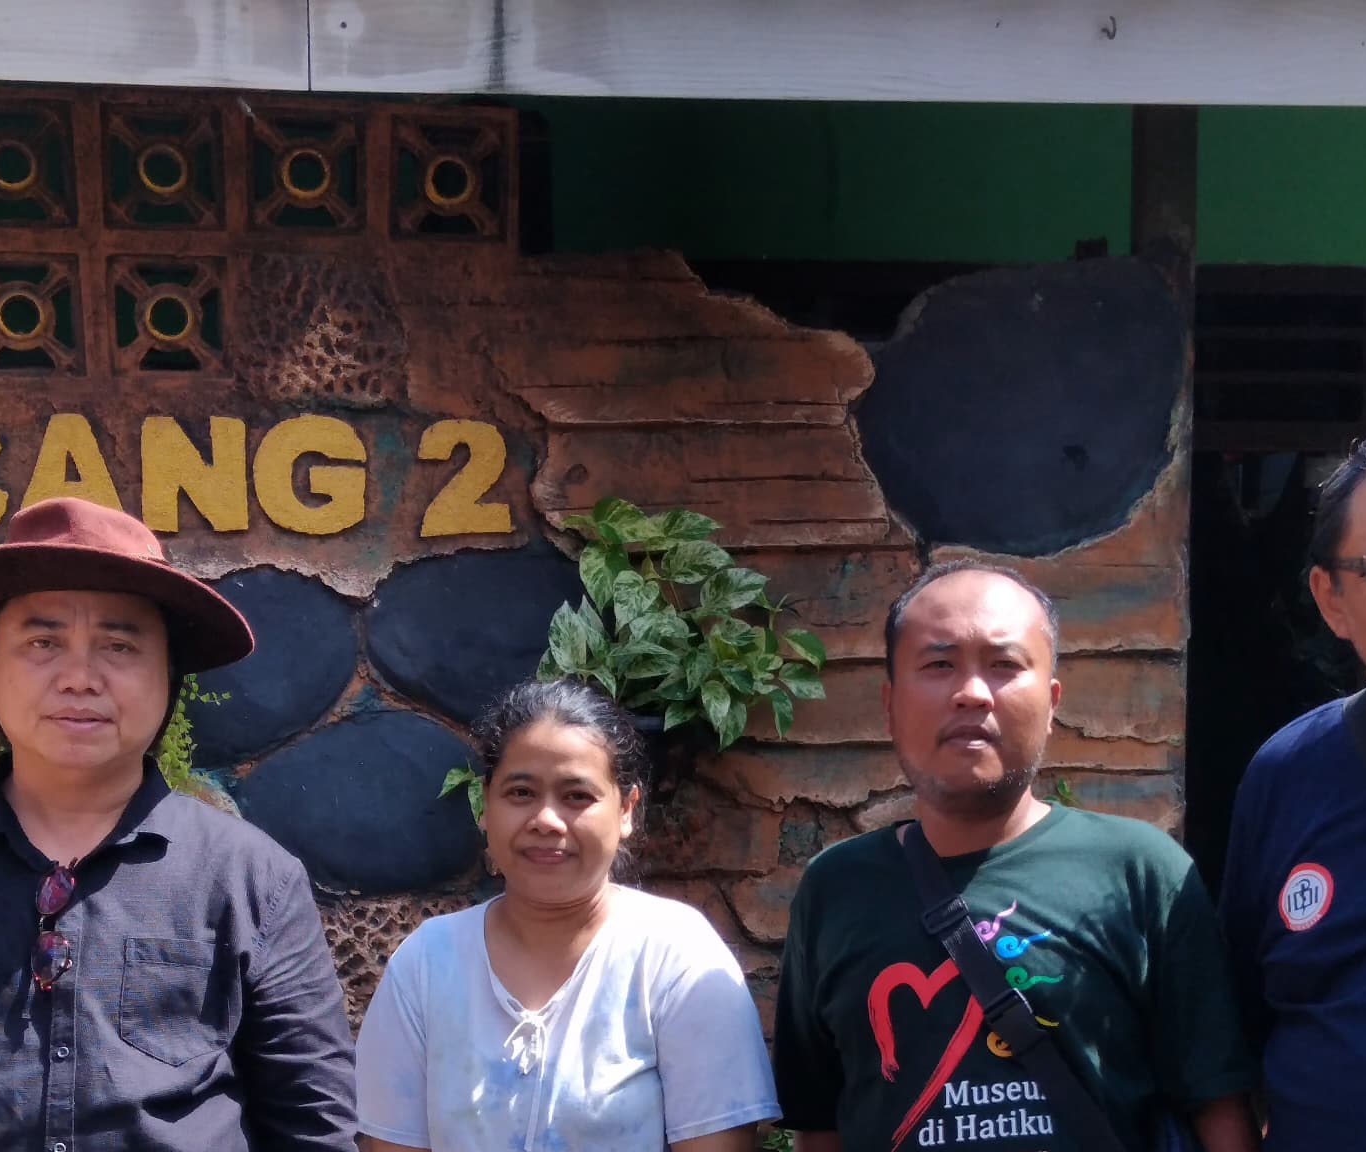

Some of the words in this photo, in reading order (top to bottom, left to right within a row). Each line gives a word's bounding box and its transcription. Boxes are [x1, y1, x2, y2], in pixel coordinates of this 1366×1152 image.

[419, 417, 513, 537] 2
[944, 1079, 1047, 1109] Museu
[918, 1118, 946, 1147] di
[954, 1108, 1054, 1142] Hatiku
